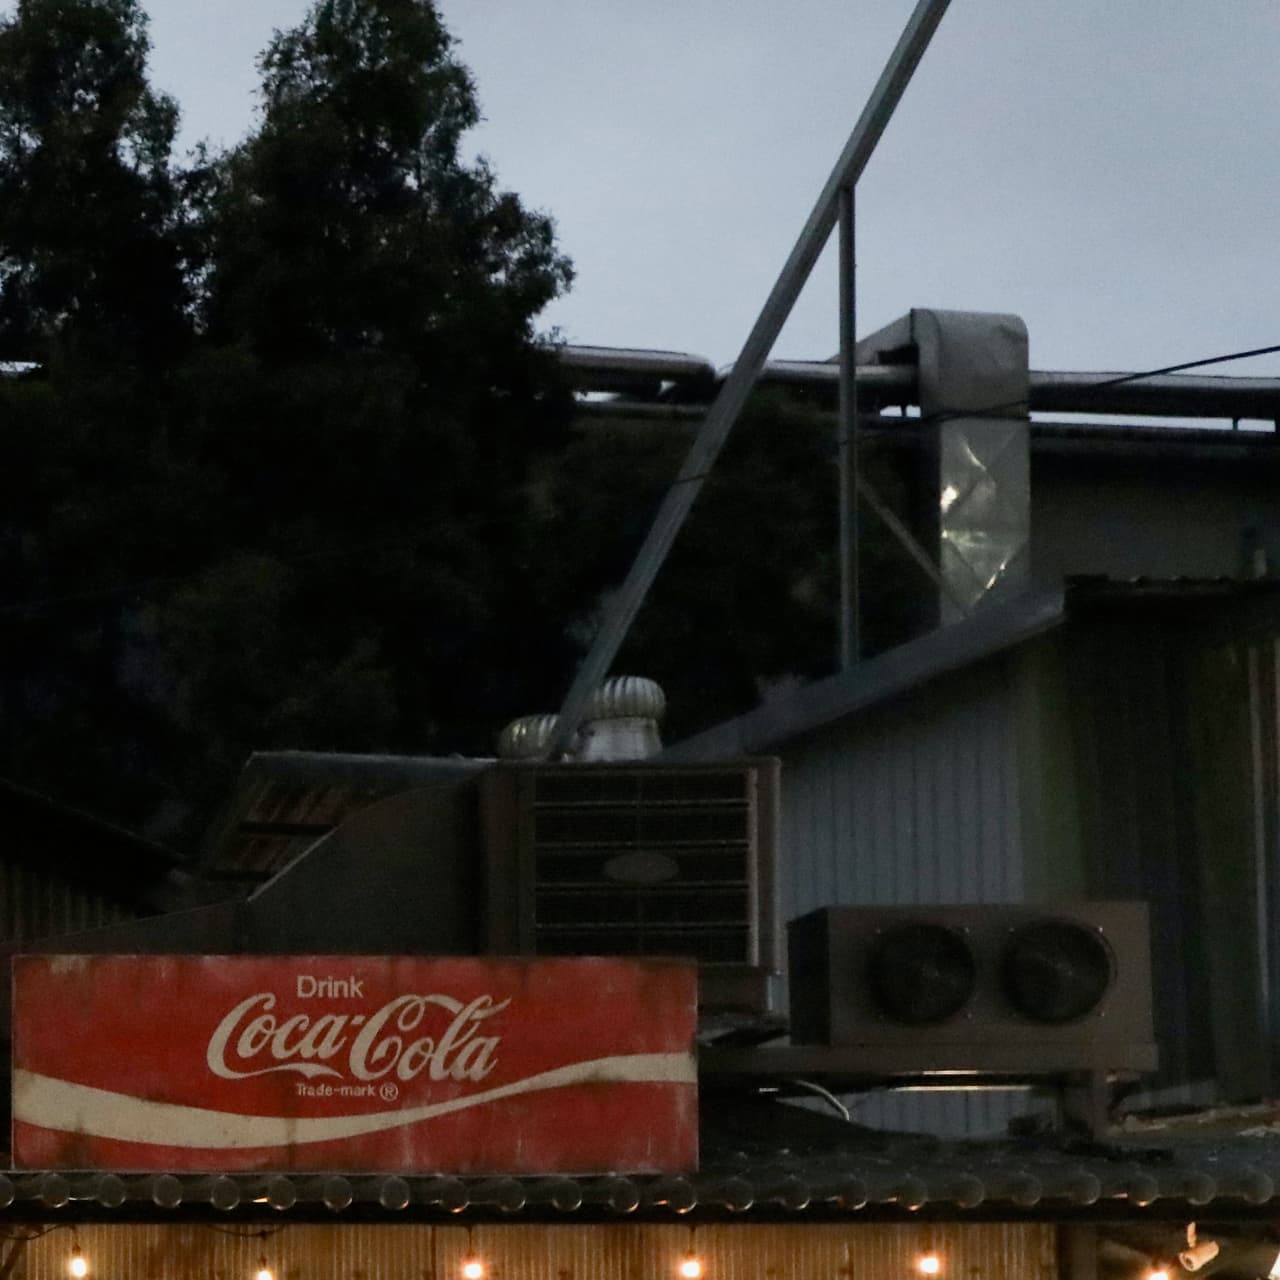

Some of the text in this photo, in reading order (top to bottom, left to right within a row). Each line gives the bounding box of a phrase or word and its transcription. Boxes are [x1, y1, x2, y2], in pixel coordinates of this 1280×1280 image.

[297, 975, 363, 998] Drink
[206, 993, 512, 1081] Coca-Cola
[296, 1083, 376, 1097] Trade-mark
